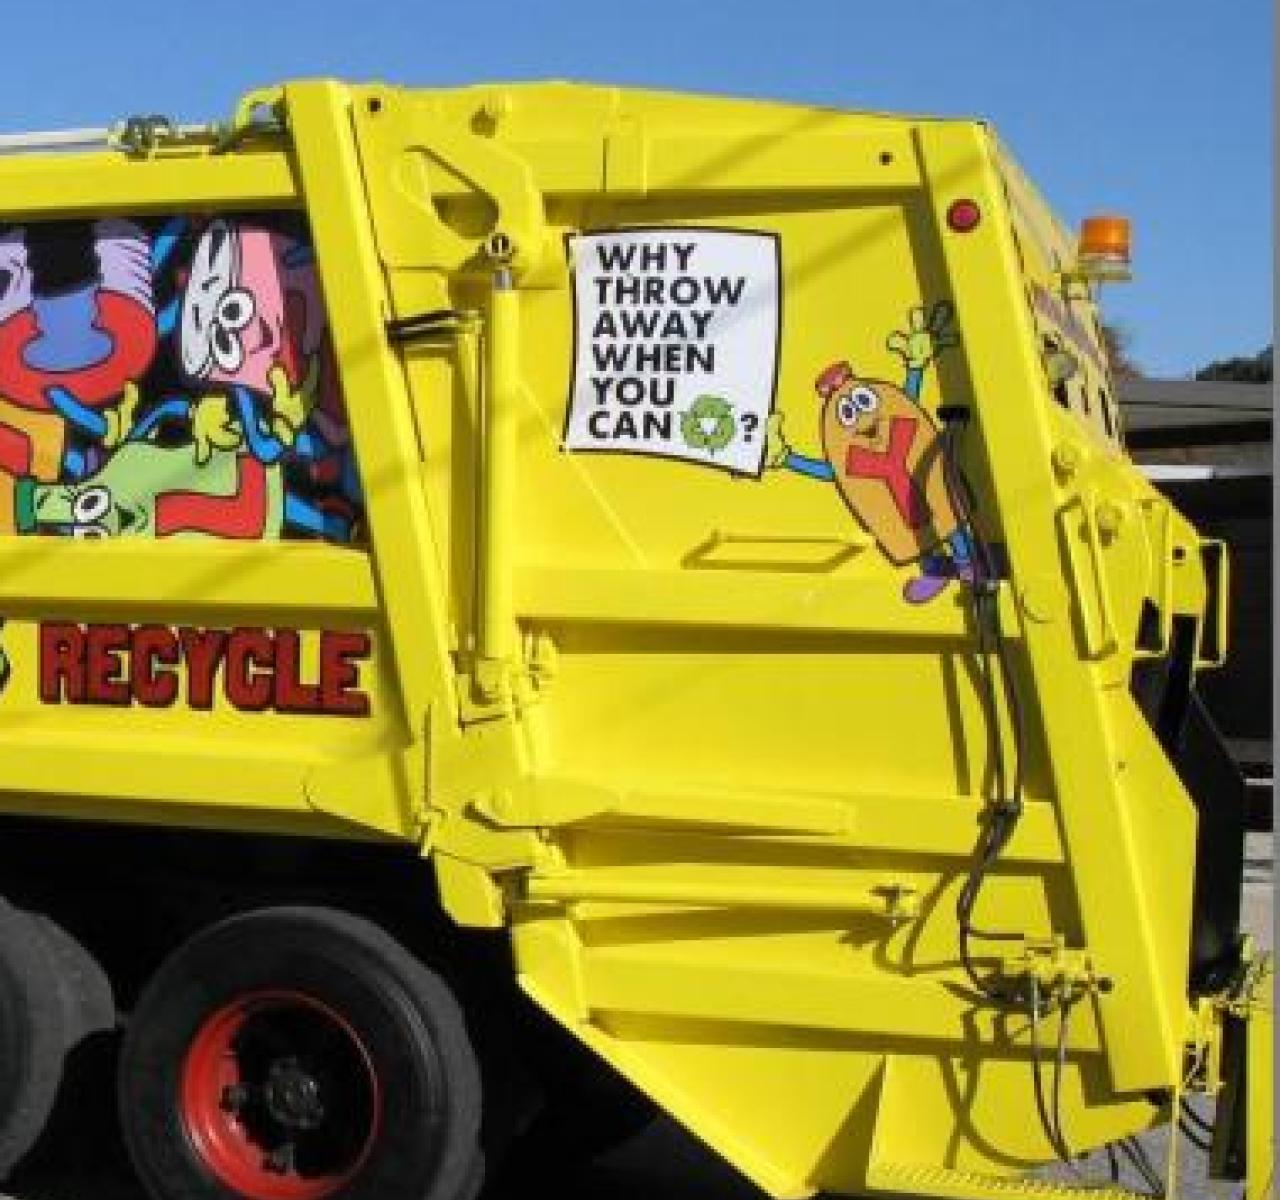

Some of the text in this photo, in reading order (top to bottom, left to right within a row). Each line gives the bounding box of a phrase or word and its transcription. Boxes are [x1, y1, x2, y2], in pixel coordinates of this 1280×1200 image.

[596, 243, 696, 272] WHY
[593, 276, 745, 305] THROW
[593, 311, 713, 339] AWAY
[592, 344, 715, 373] WHEN
[590, 377, 676, 405] YOU
[588, 411, 673, 440] CAN
[39, 622, 372, 716] RECYCLE
